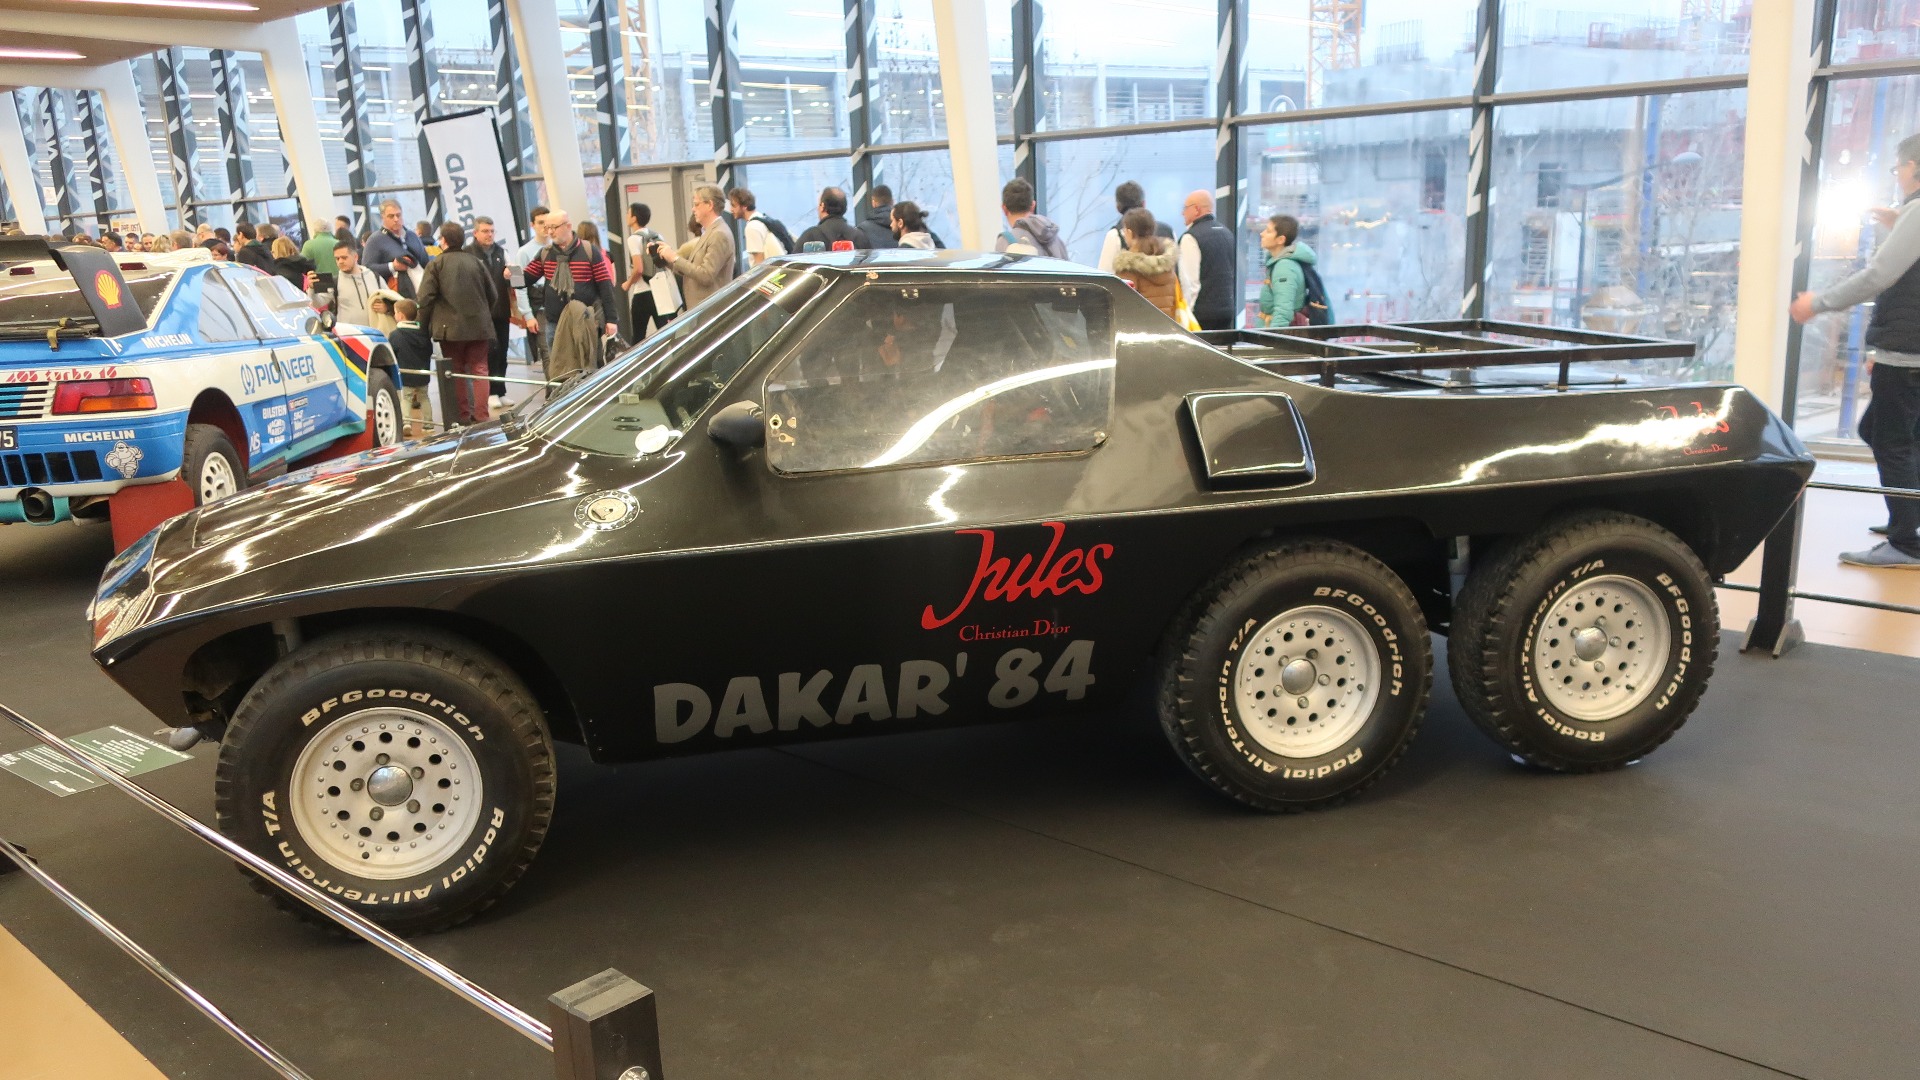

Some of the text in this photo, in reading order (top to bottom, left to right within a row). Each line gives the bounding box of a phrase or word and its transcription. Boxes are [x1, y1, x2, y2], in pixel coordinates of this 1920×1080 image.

[141, 334, 193, 349] MICHELIN
[6, 366, 117, 383] 405 turbo 16
[254, 355, 316, 387] PIONEER
[0, 430, 14, 448] 5
[64, 429, 135, 443] MICHELIN
[920, 521, 1114, 630] Jules
[959, 619, 1071, 641] Christian Dior
[1313, 586, 1404, 697] BFGoodrich
[1521, 559, 1606, 742] Radial All-Terrain T/A
[1655, 572, 1692, 711] BFGoodrich
[301, 688, 485, 742] BFGoodrich
[1219, 617, 1364, 780] Radial All-Terrain T/A
[262, 789, 505, 905] Radial All-Terrain T/A
